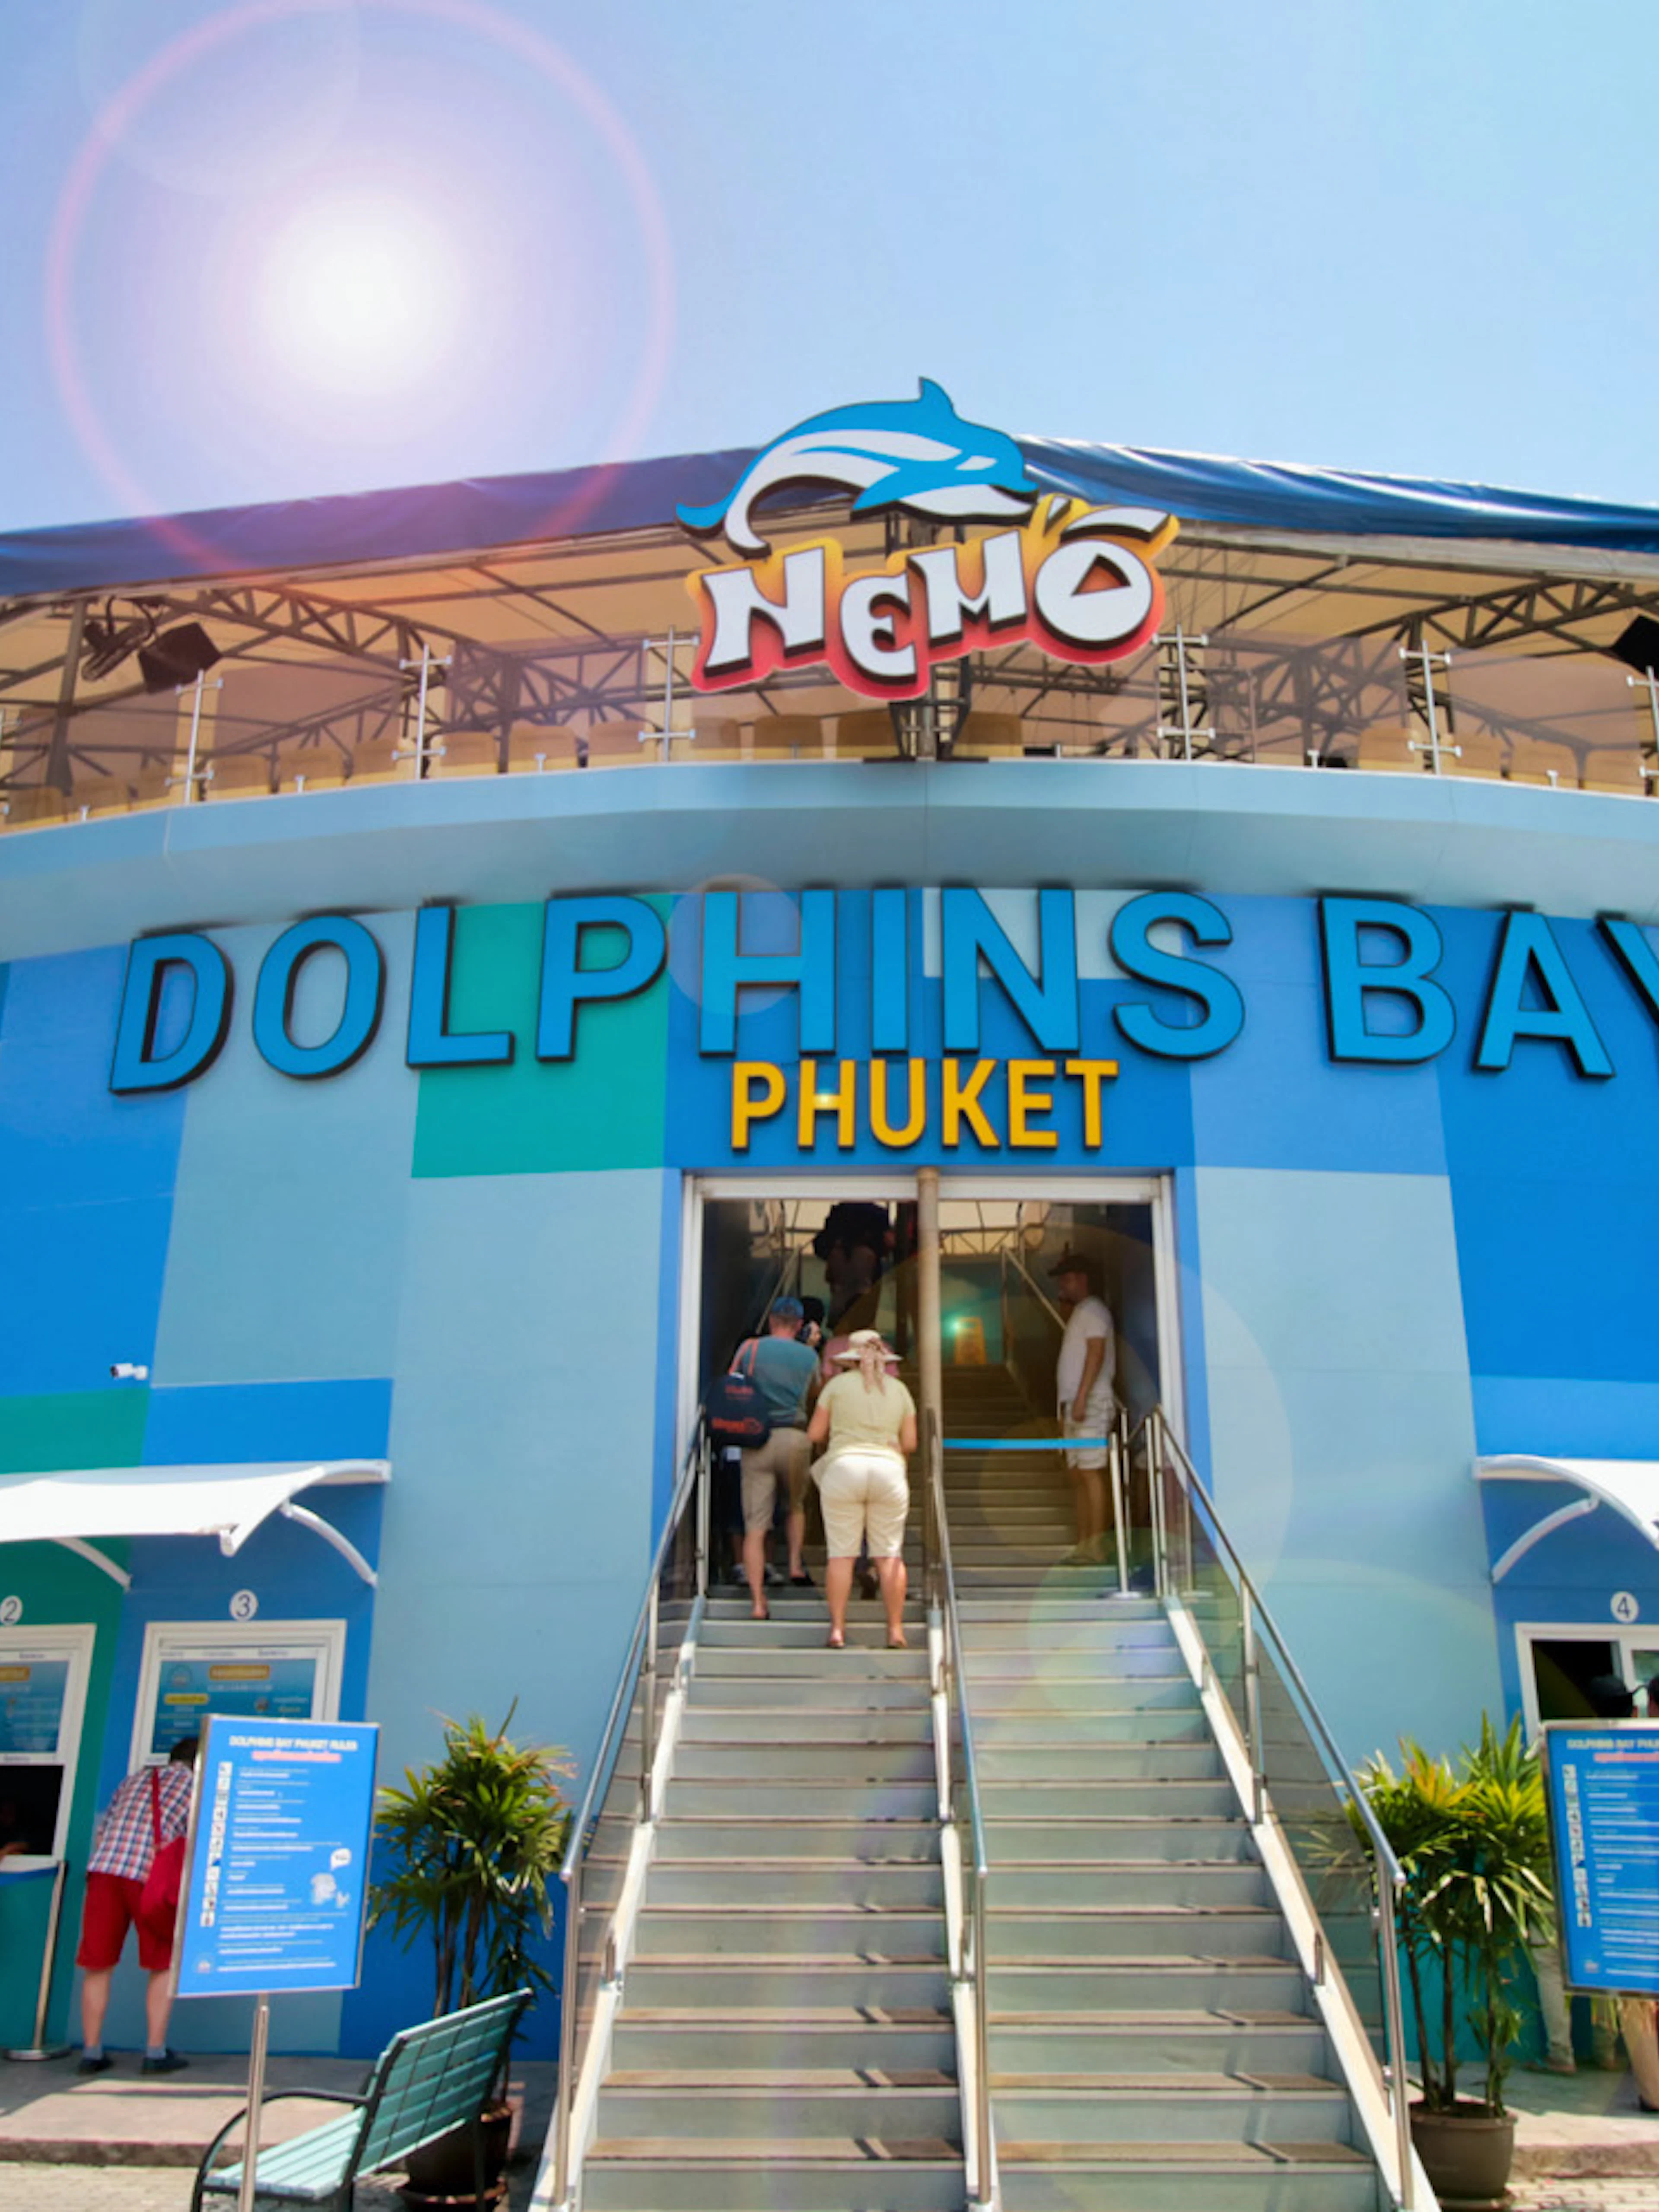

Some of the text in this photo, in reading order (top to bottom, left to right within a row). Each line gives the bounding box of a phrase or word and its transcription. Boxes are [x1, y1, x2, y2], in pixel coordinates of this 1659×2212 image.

[699, 528, 1154, 684] NEMO
[108, 885, 1246, 1096] DOLPHINS
[731, 1057, 1120, 1151] PHUKET
[3, 1599, 18, 1621] 2
[236, 1593, 250, 1618] 3
[1617, 1595, 1630, 1619] 4
